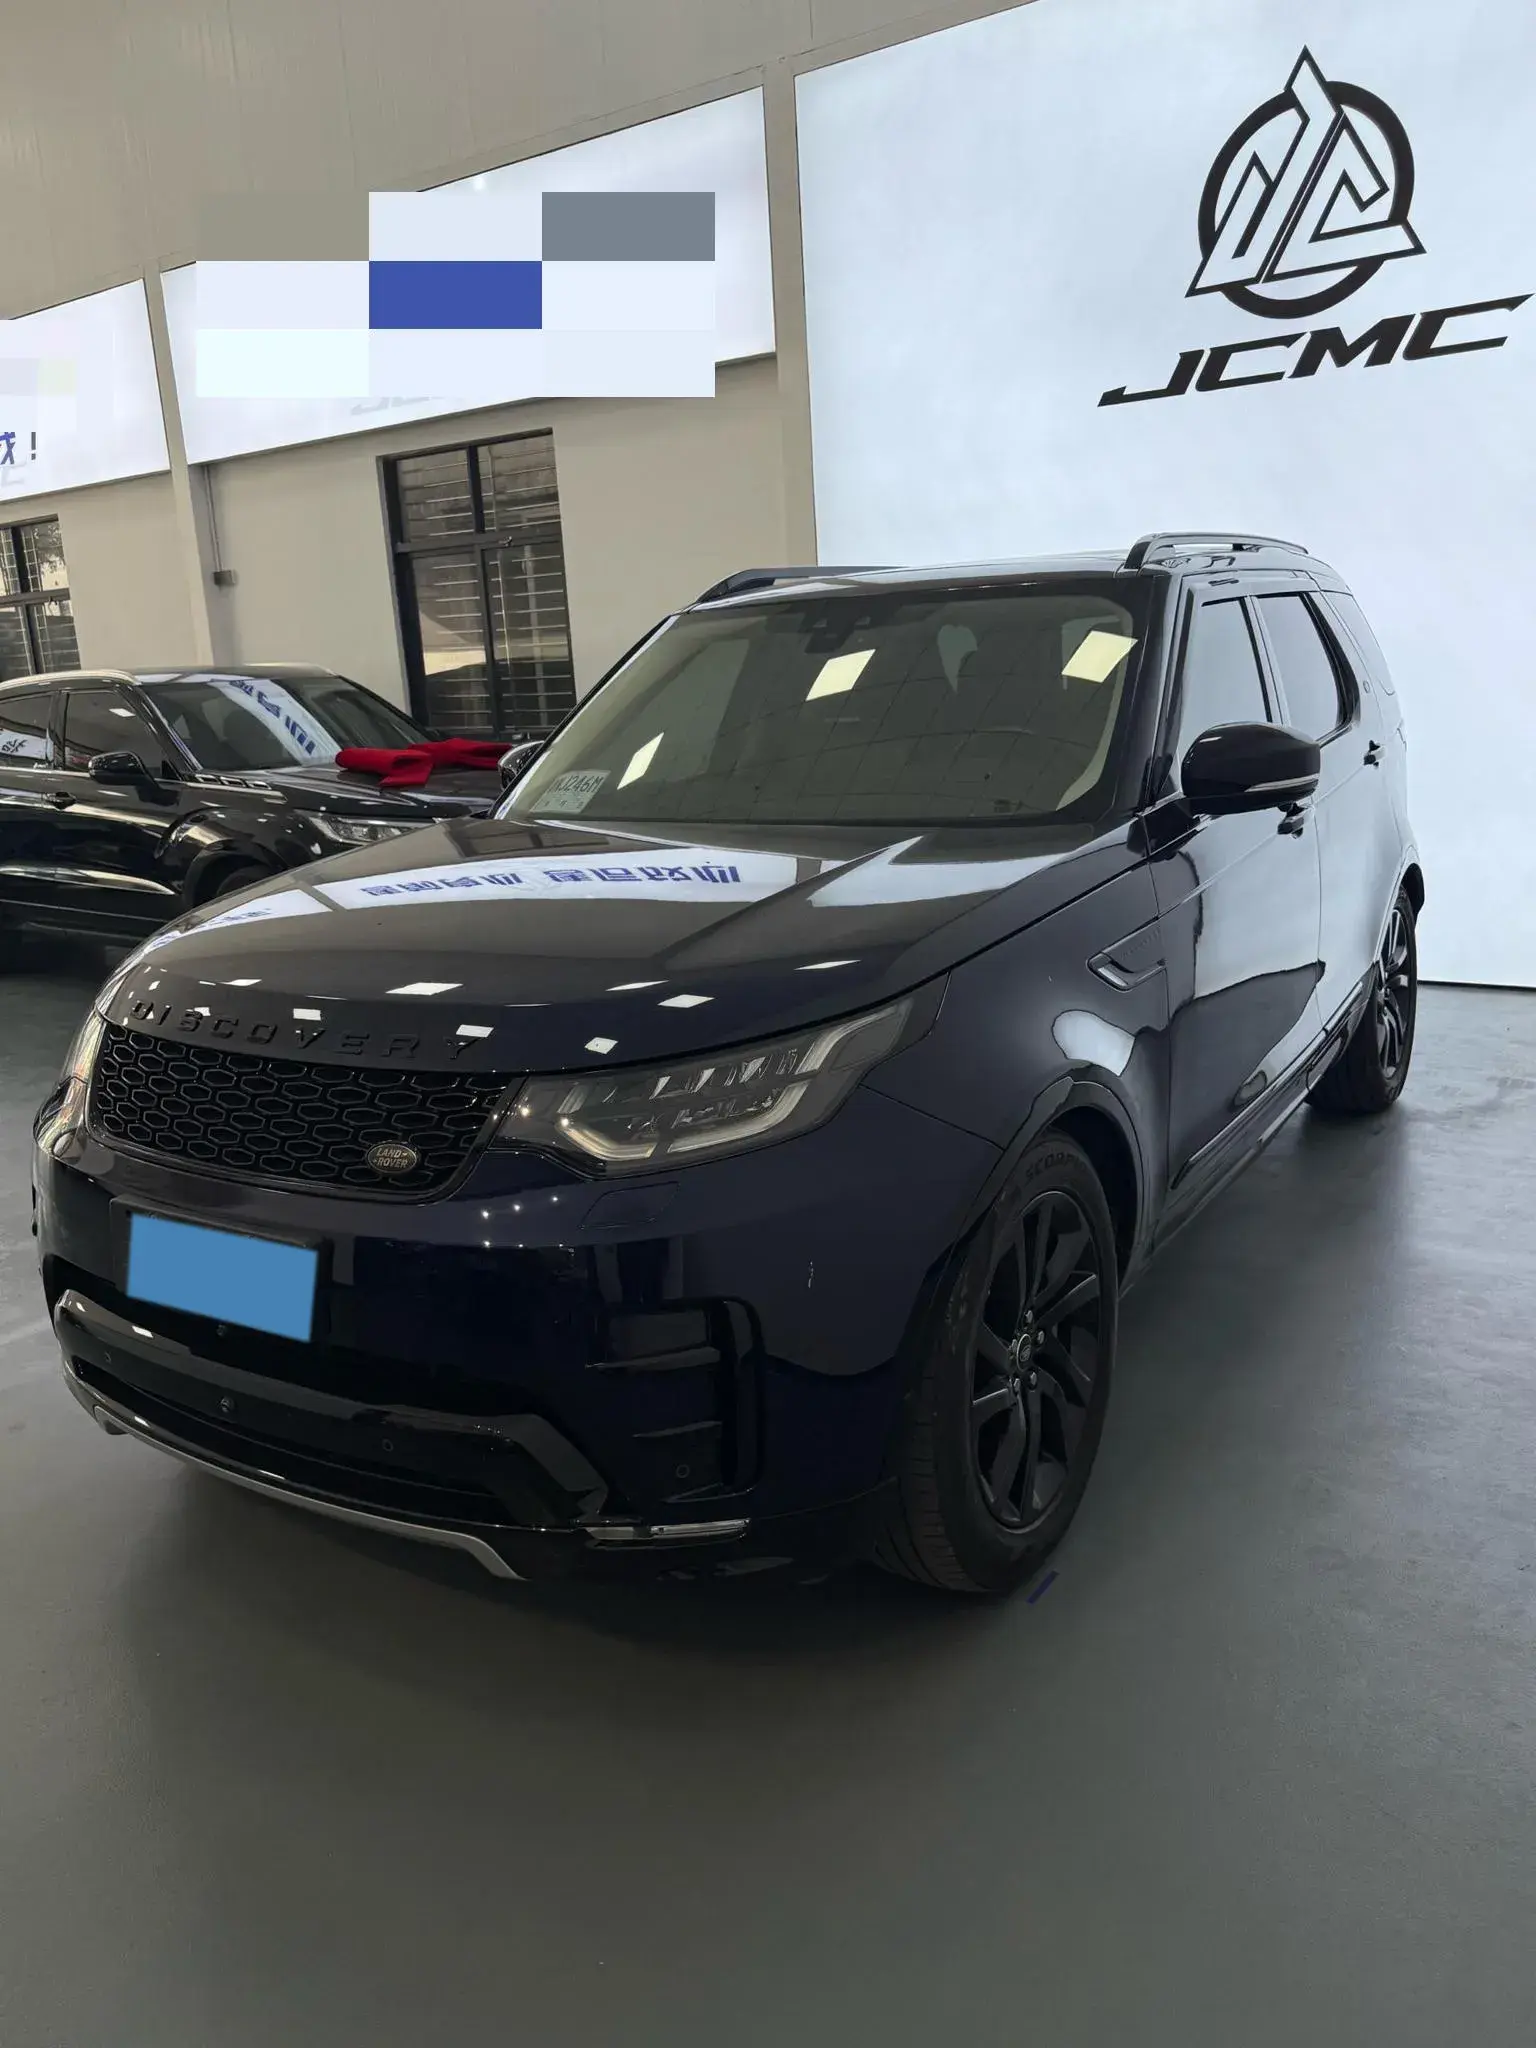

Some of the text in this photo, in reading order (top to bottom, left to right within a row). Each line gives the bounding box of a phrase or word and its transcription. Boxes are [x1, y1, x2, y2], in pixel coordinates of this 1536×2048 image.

[1097, 293, 1535, 407] JCMC
[130, 1000, 485, 1060] DISCOVERY
[376, 1148, 402, 1158] LAND
[377, 1157, 408, 1168] ROVER
